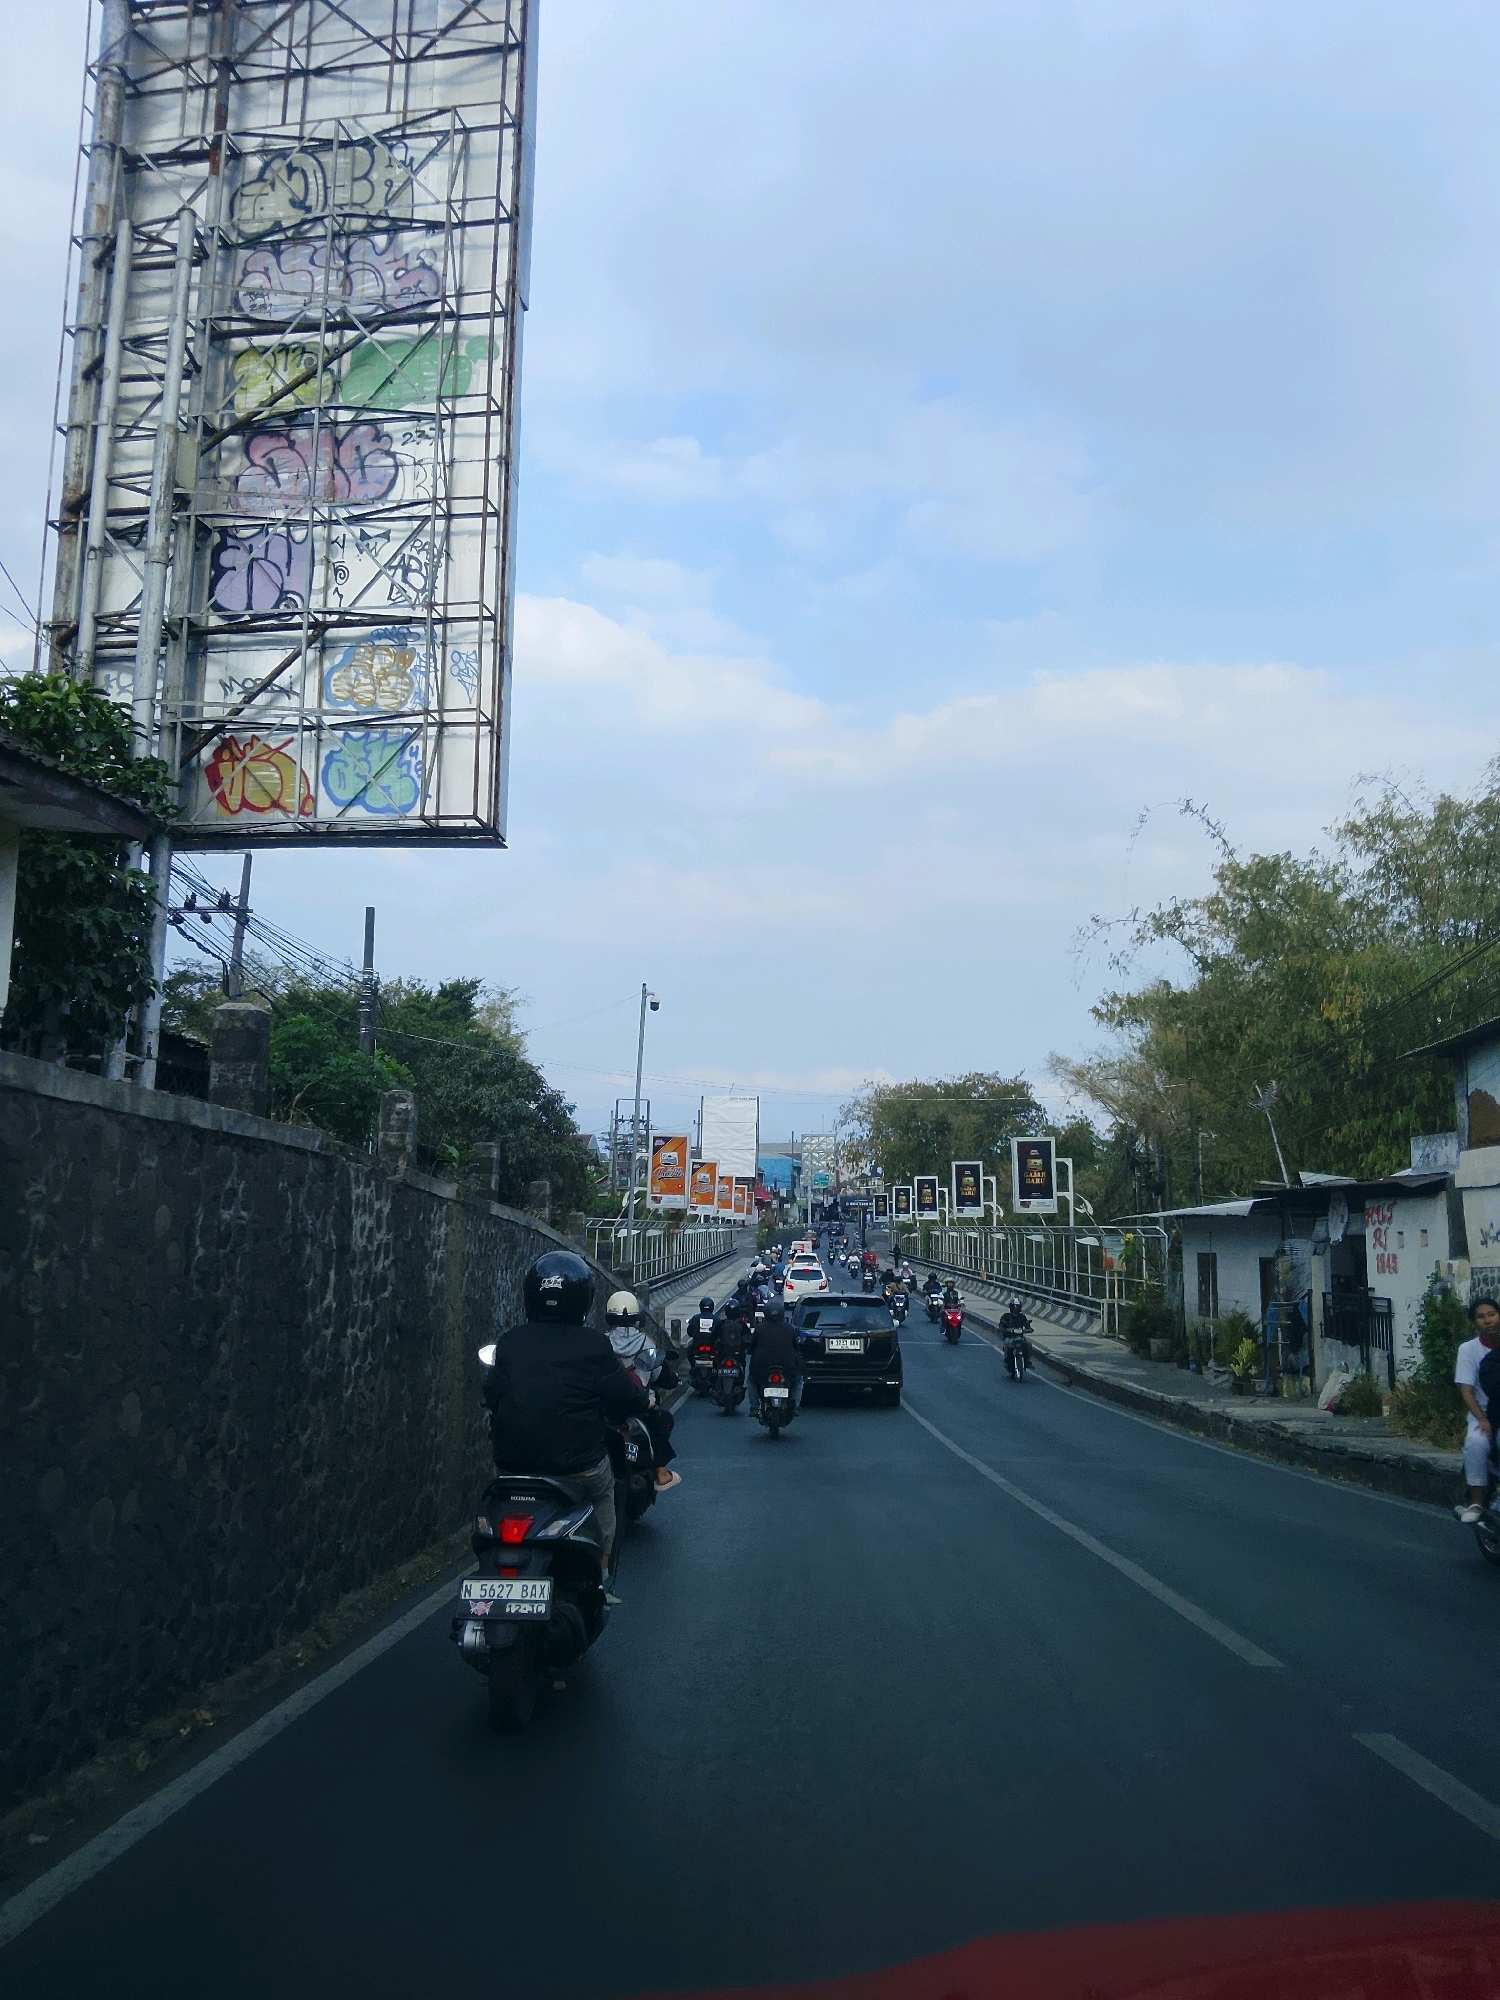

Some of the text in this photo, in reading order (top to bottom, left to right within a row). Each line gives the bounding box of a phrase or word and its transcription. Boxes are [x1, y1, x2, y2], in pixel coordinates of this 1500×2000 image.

[463, 1583, 546, 1599] N 5627 BAX
